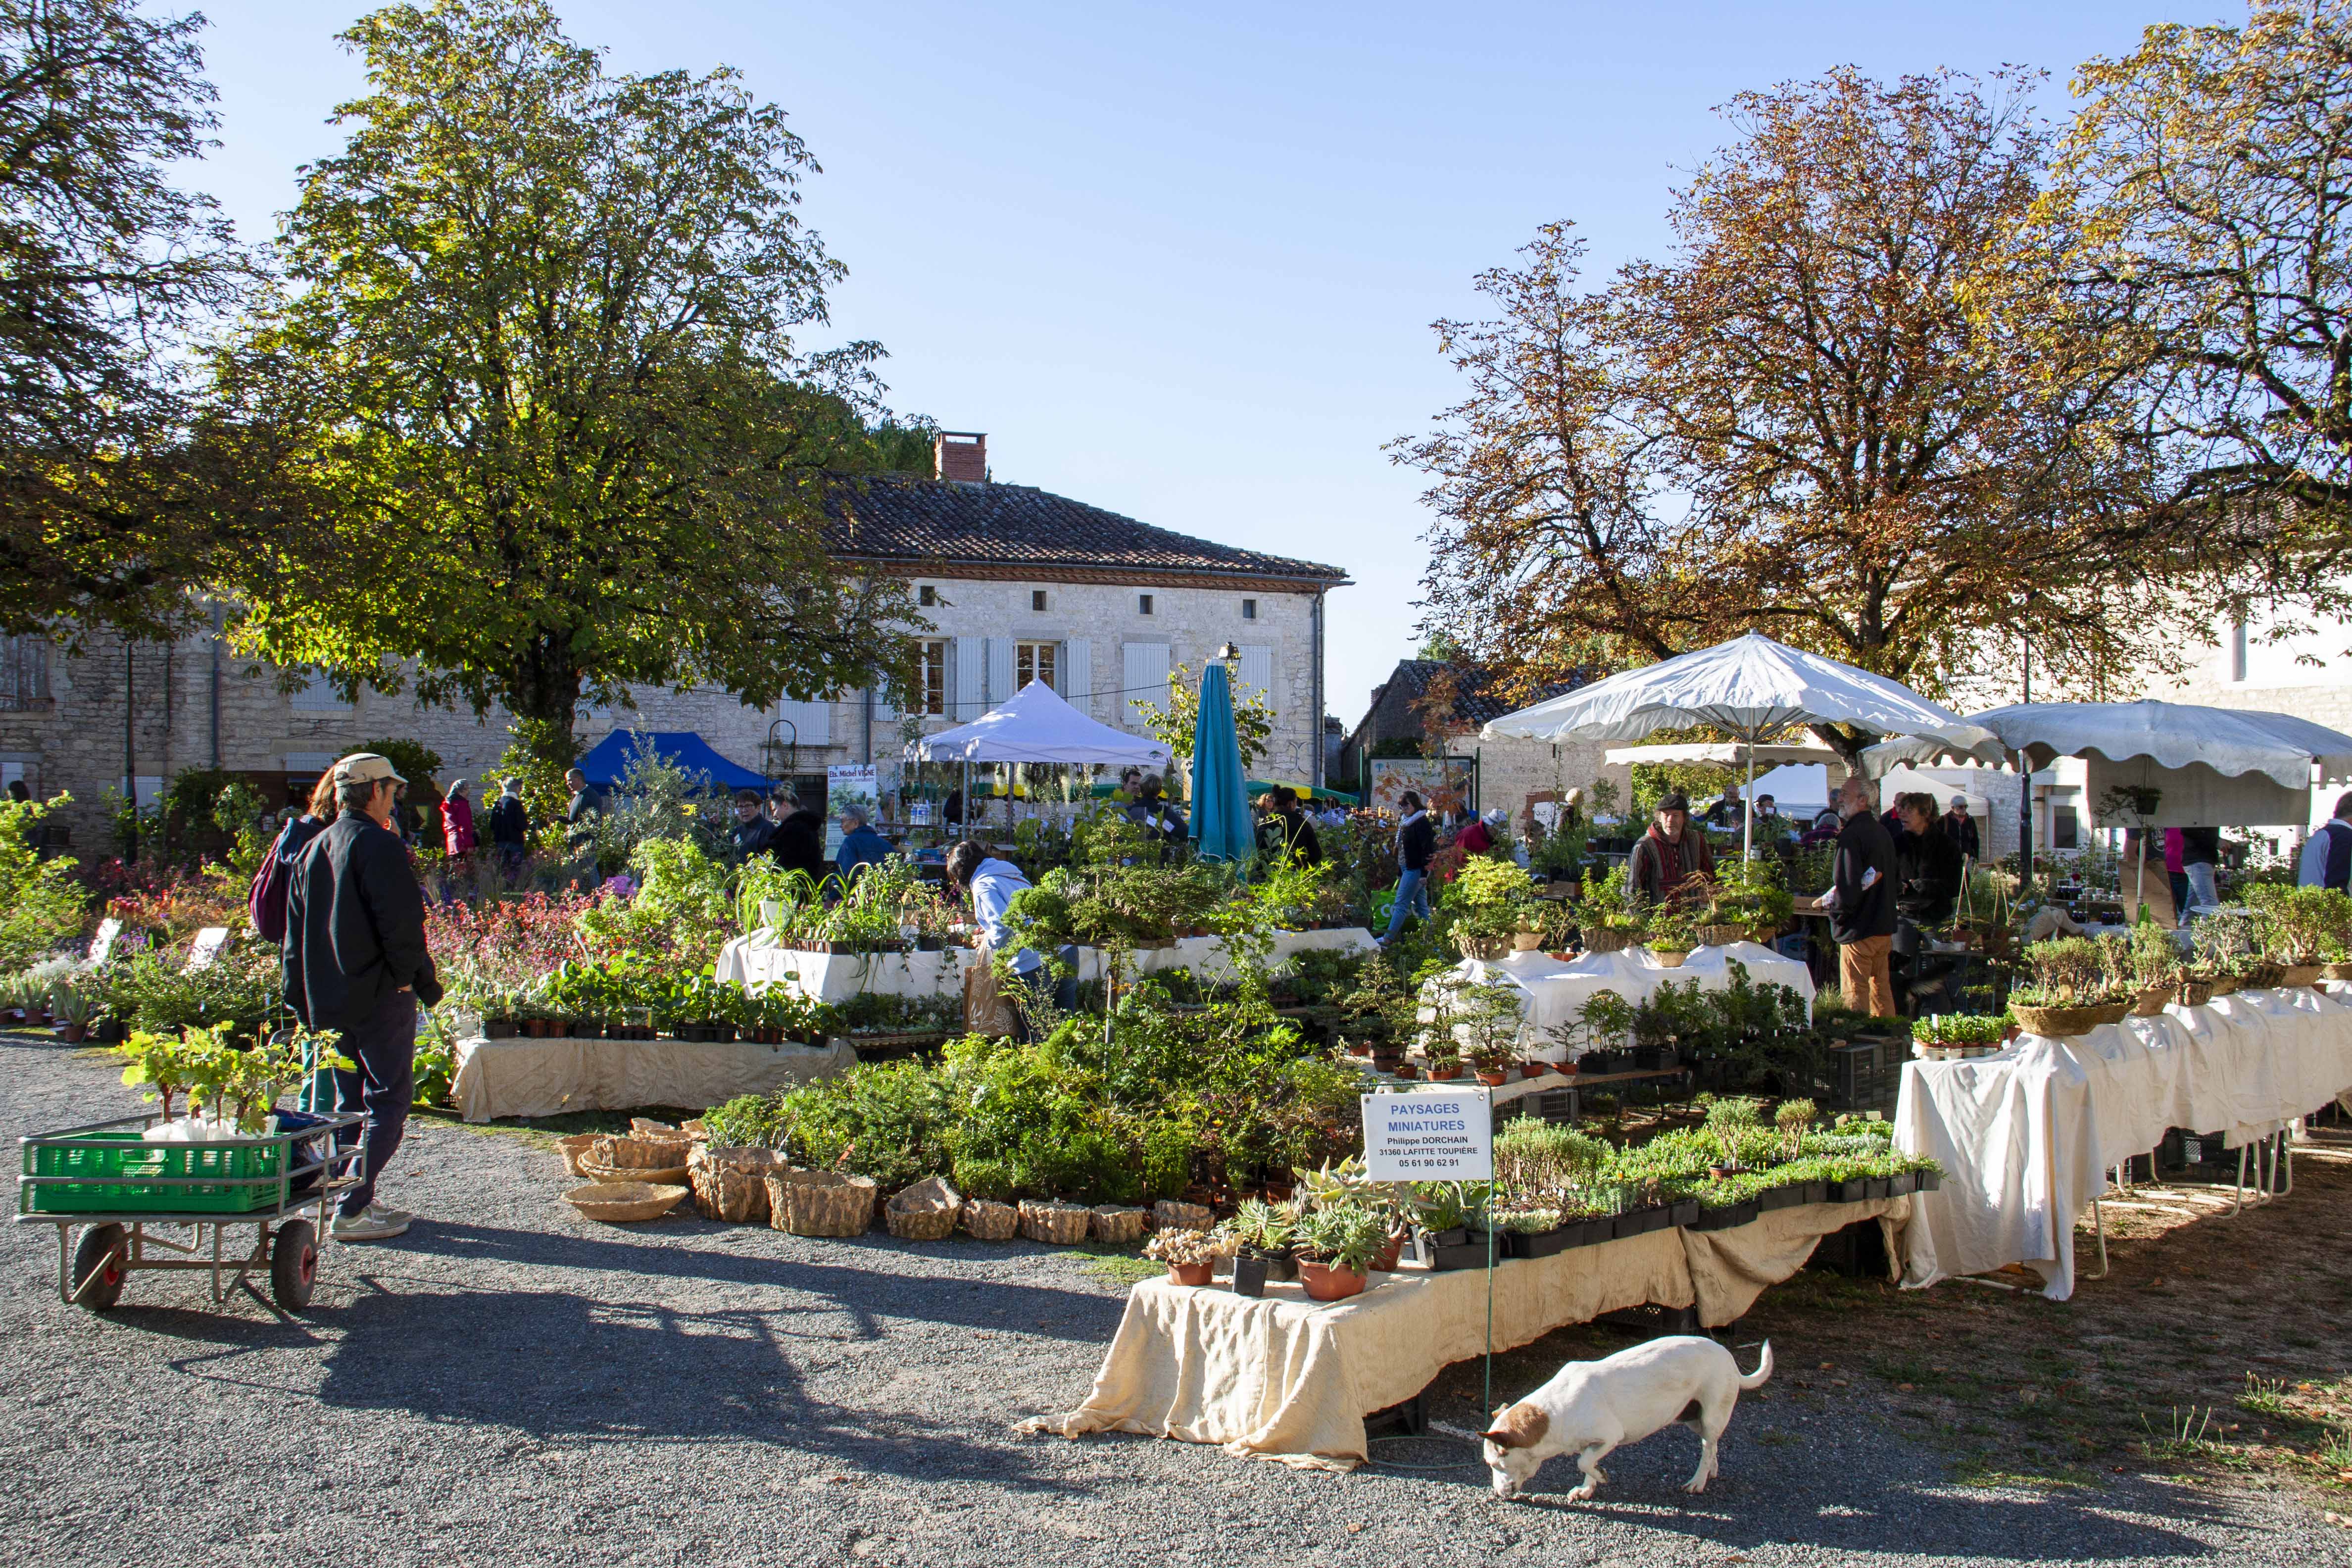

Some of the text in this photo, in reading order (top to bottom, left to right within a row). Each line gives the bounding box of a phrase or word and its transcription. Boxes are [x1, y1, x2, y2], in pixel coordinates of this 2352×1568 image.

[1391, 1103, 1460, 1115] PAYSAGES
[1388, 1120, 1465, 1132] MINIATURES
[1387, 1137, 1420, 1146] Philippe
[1437, 1146, 1478, 1155] TOUPIÈRE
